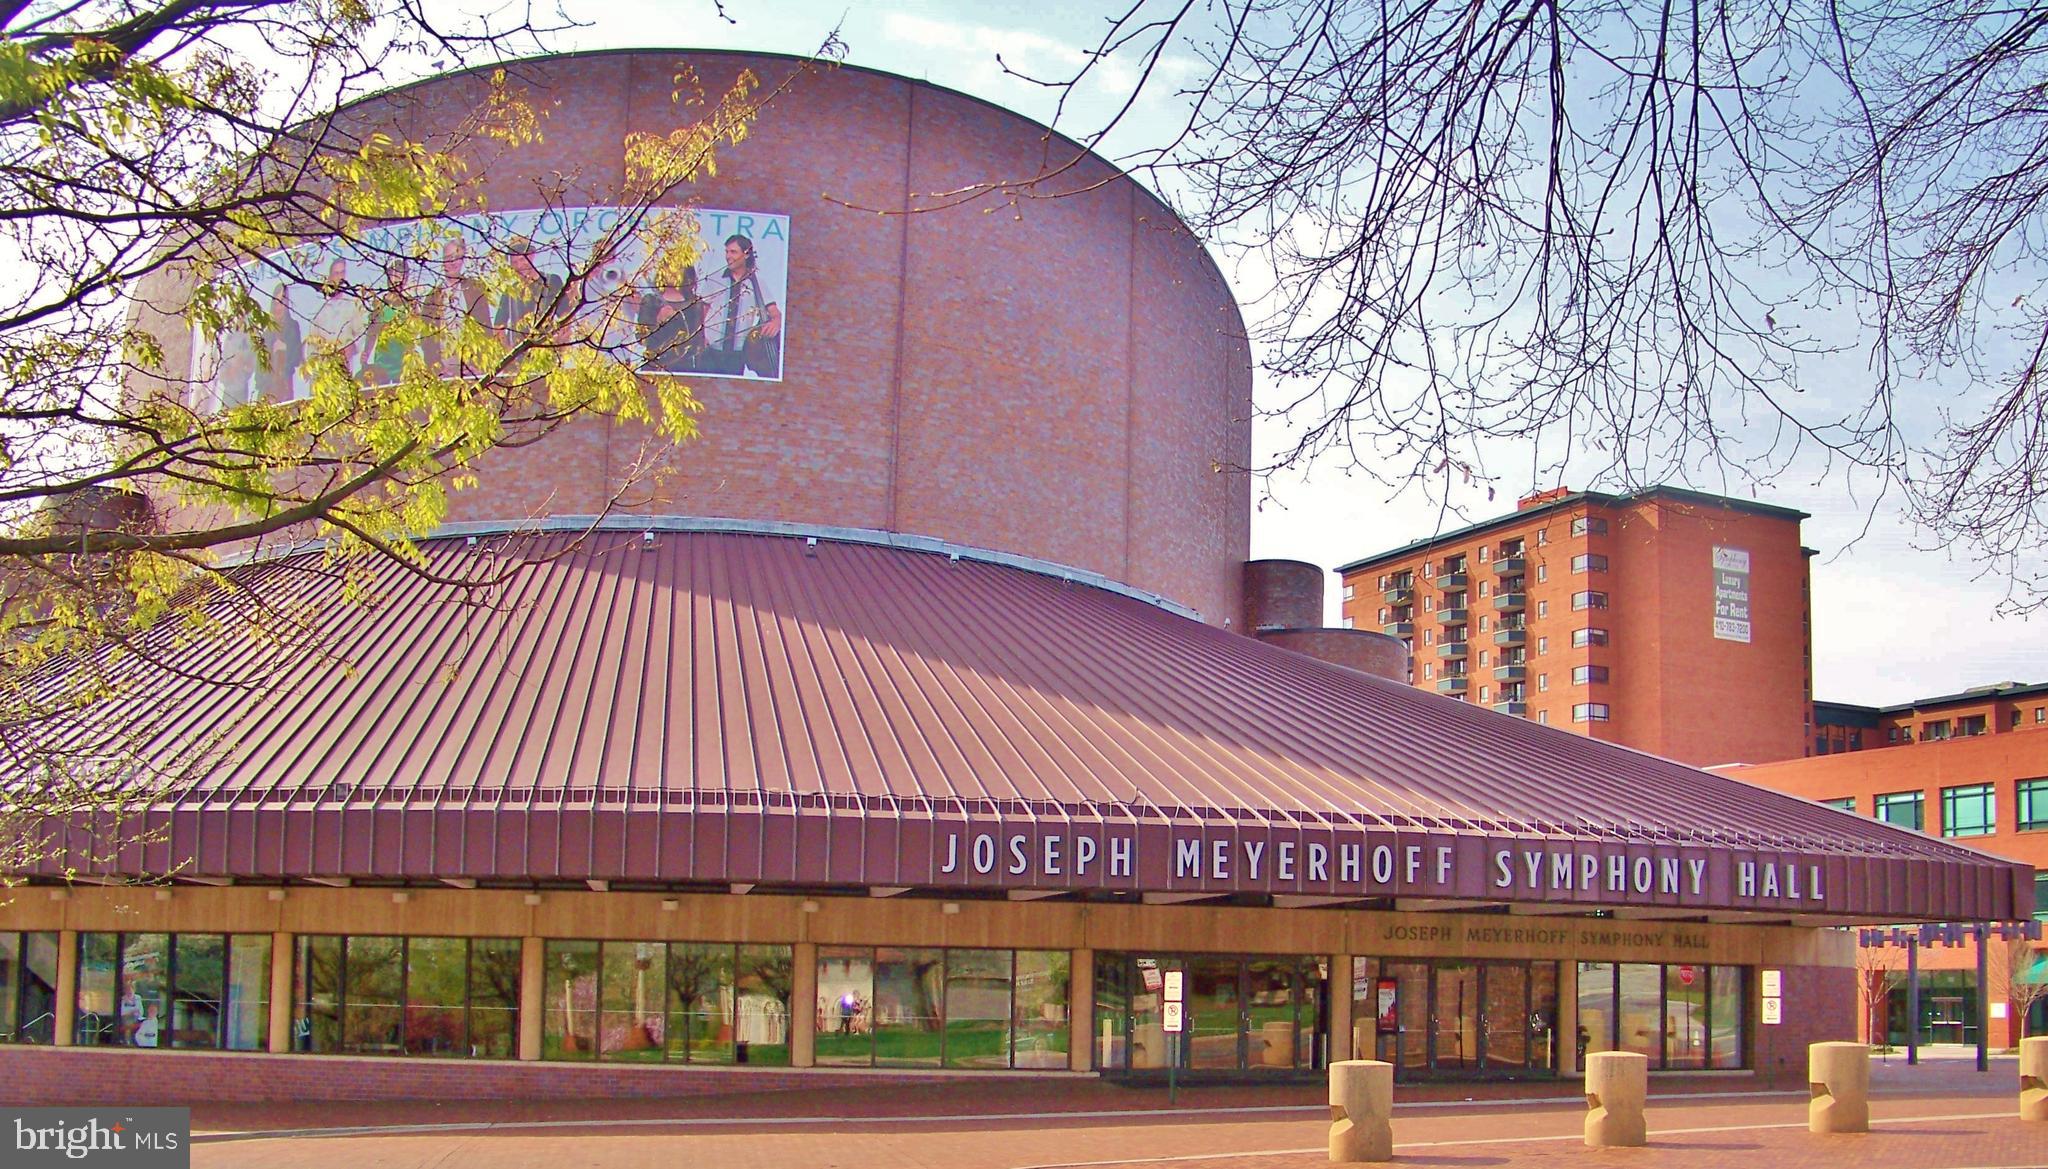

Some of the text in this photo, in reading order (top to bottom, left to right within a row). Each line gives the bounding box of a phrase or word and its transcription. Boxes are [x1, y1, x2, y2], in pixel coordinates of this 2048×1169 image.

[539, 209, 785, 242] ORCHTRA
[1722, 572, 1740, 590] Luxury
[1715, 585, 1748, 602] Apartments
[1715, 600, 1748, 619] For Rent
[940, 833, 1824, 900] JOSEPH MEYERHOFF SYMPHONY HALL
[1383, 926, 1710, 950] JOSEPH MEYERHOFF SYMPHONY HALL
